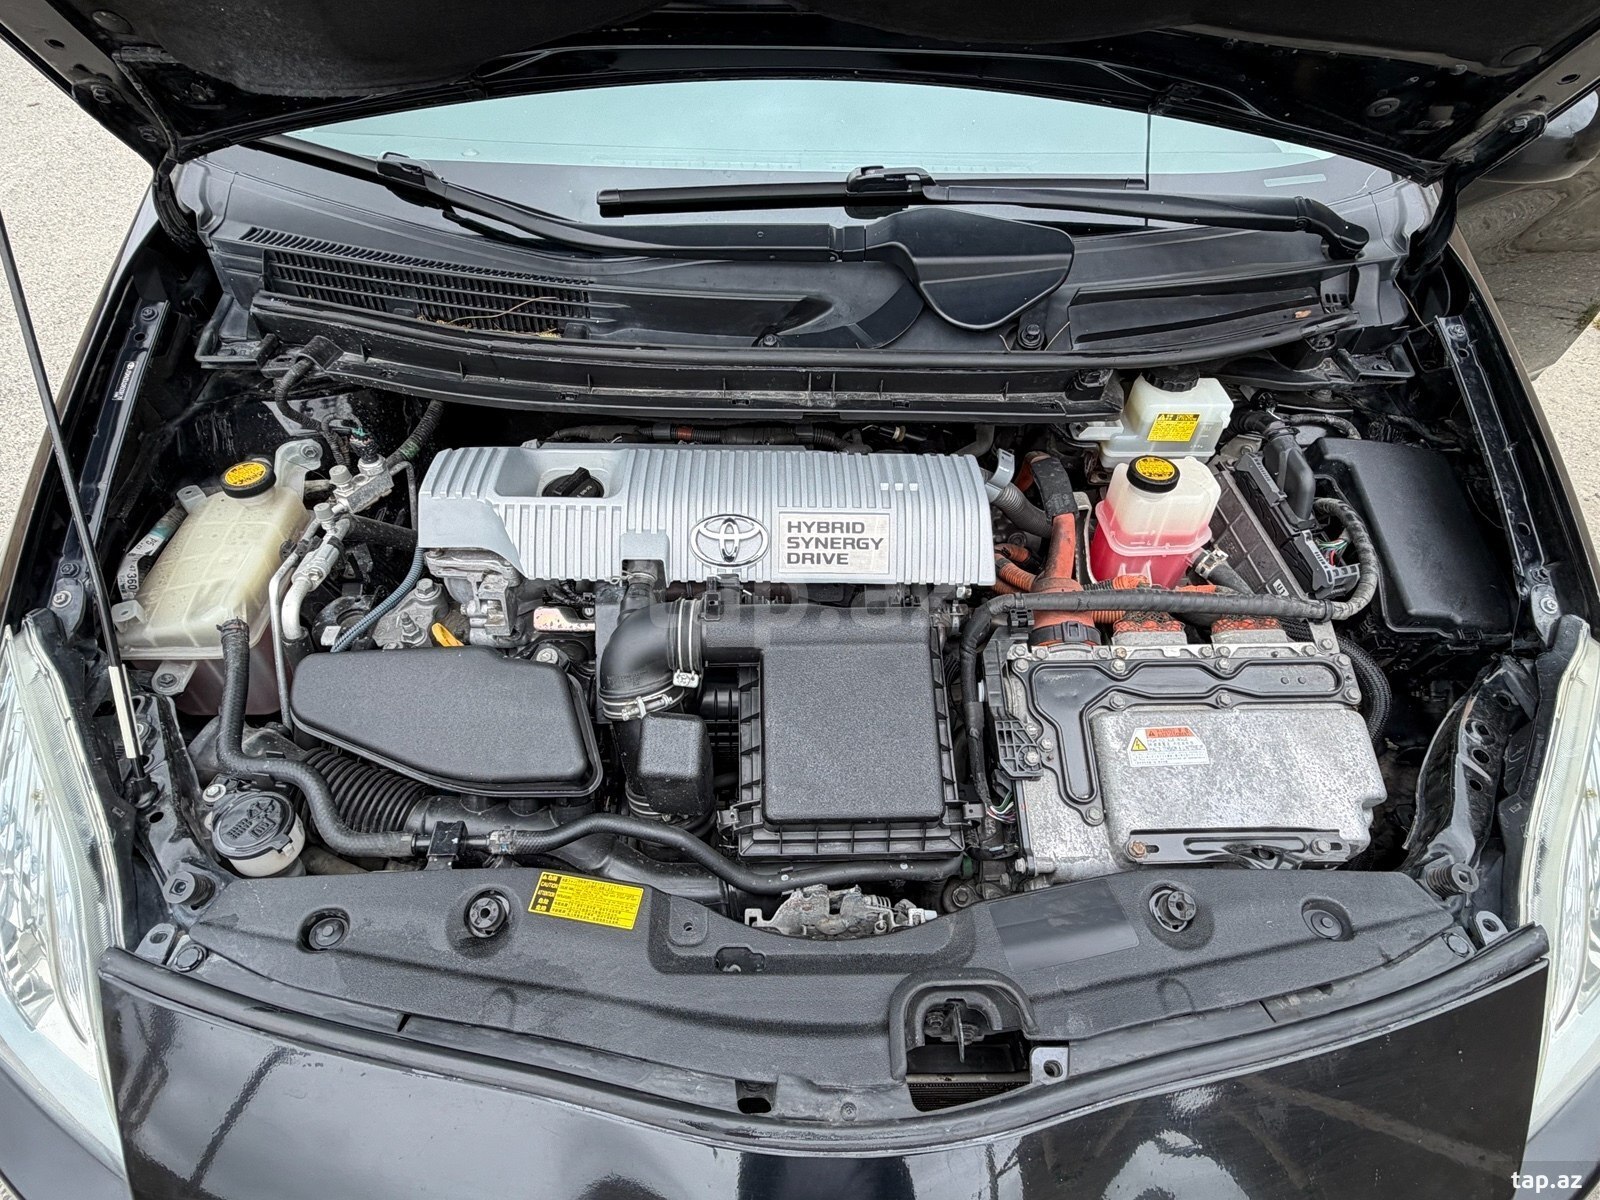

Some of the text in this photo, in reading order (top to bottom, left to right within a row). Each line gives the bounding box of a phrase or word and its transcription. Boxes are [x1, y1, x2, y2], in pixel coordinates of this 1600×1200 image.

[786, 521, 865, 534] HYBRID
[786, 536, 884, 550] SYNERGY
[786, 552, 849, 565] DRIVE
[540, 881, 559, 889] CAUTION
